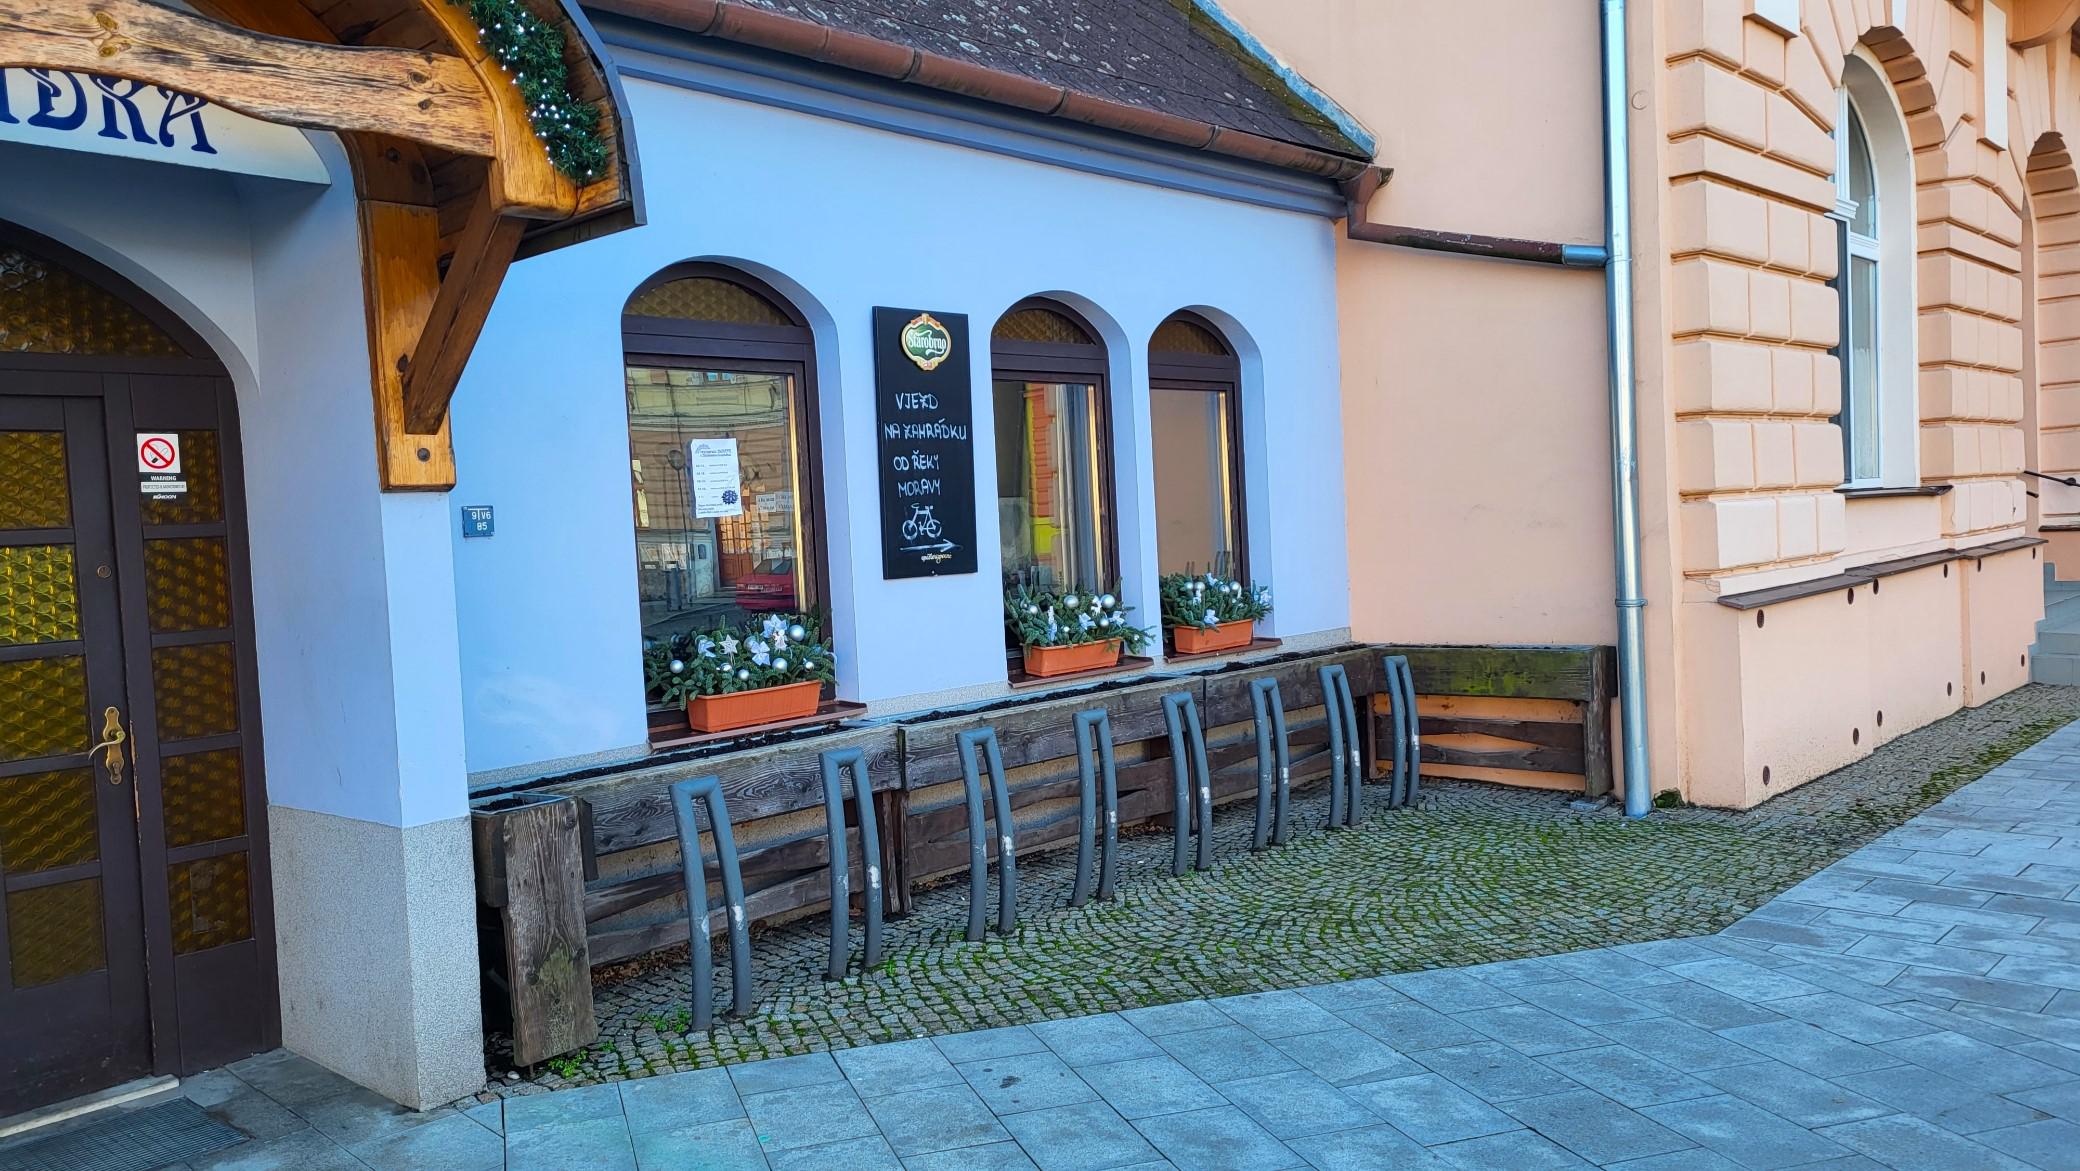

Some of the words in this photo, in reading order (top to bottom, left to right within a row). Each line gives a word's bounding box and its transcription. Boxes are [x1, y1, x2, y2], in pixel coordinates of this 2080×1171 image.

[907, 329, 947, 355] Starobrno
[895, 392, 938, 410] VJEZD
[884, 423, 900, 440] NA
[903, 418, 967, 440] ZAHRÁDKU
[893, 456, 910, 471] OD
[911, 449, 940, 470] ŘEKY
[897, 478, 941, 498] MORAVY
